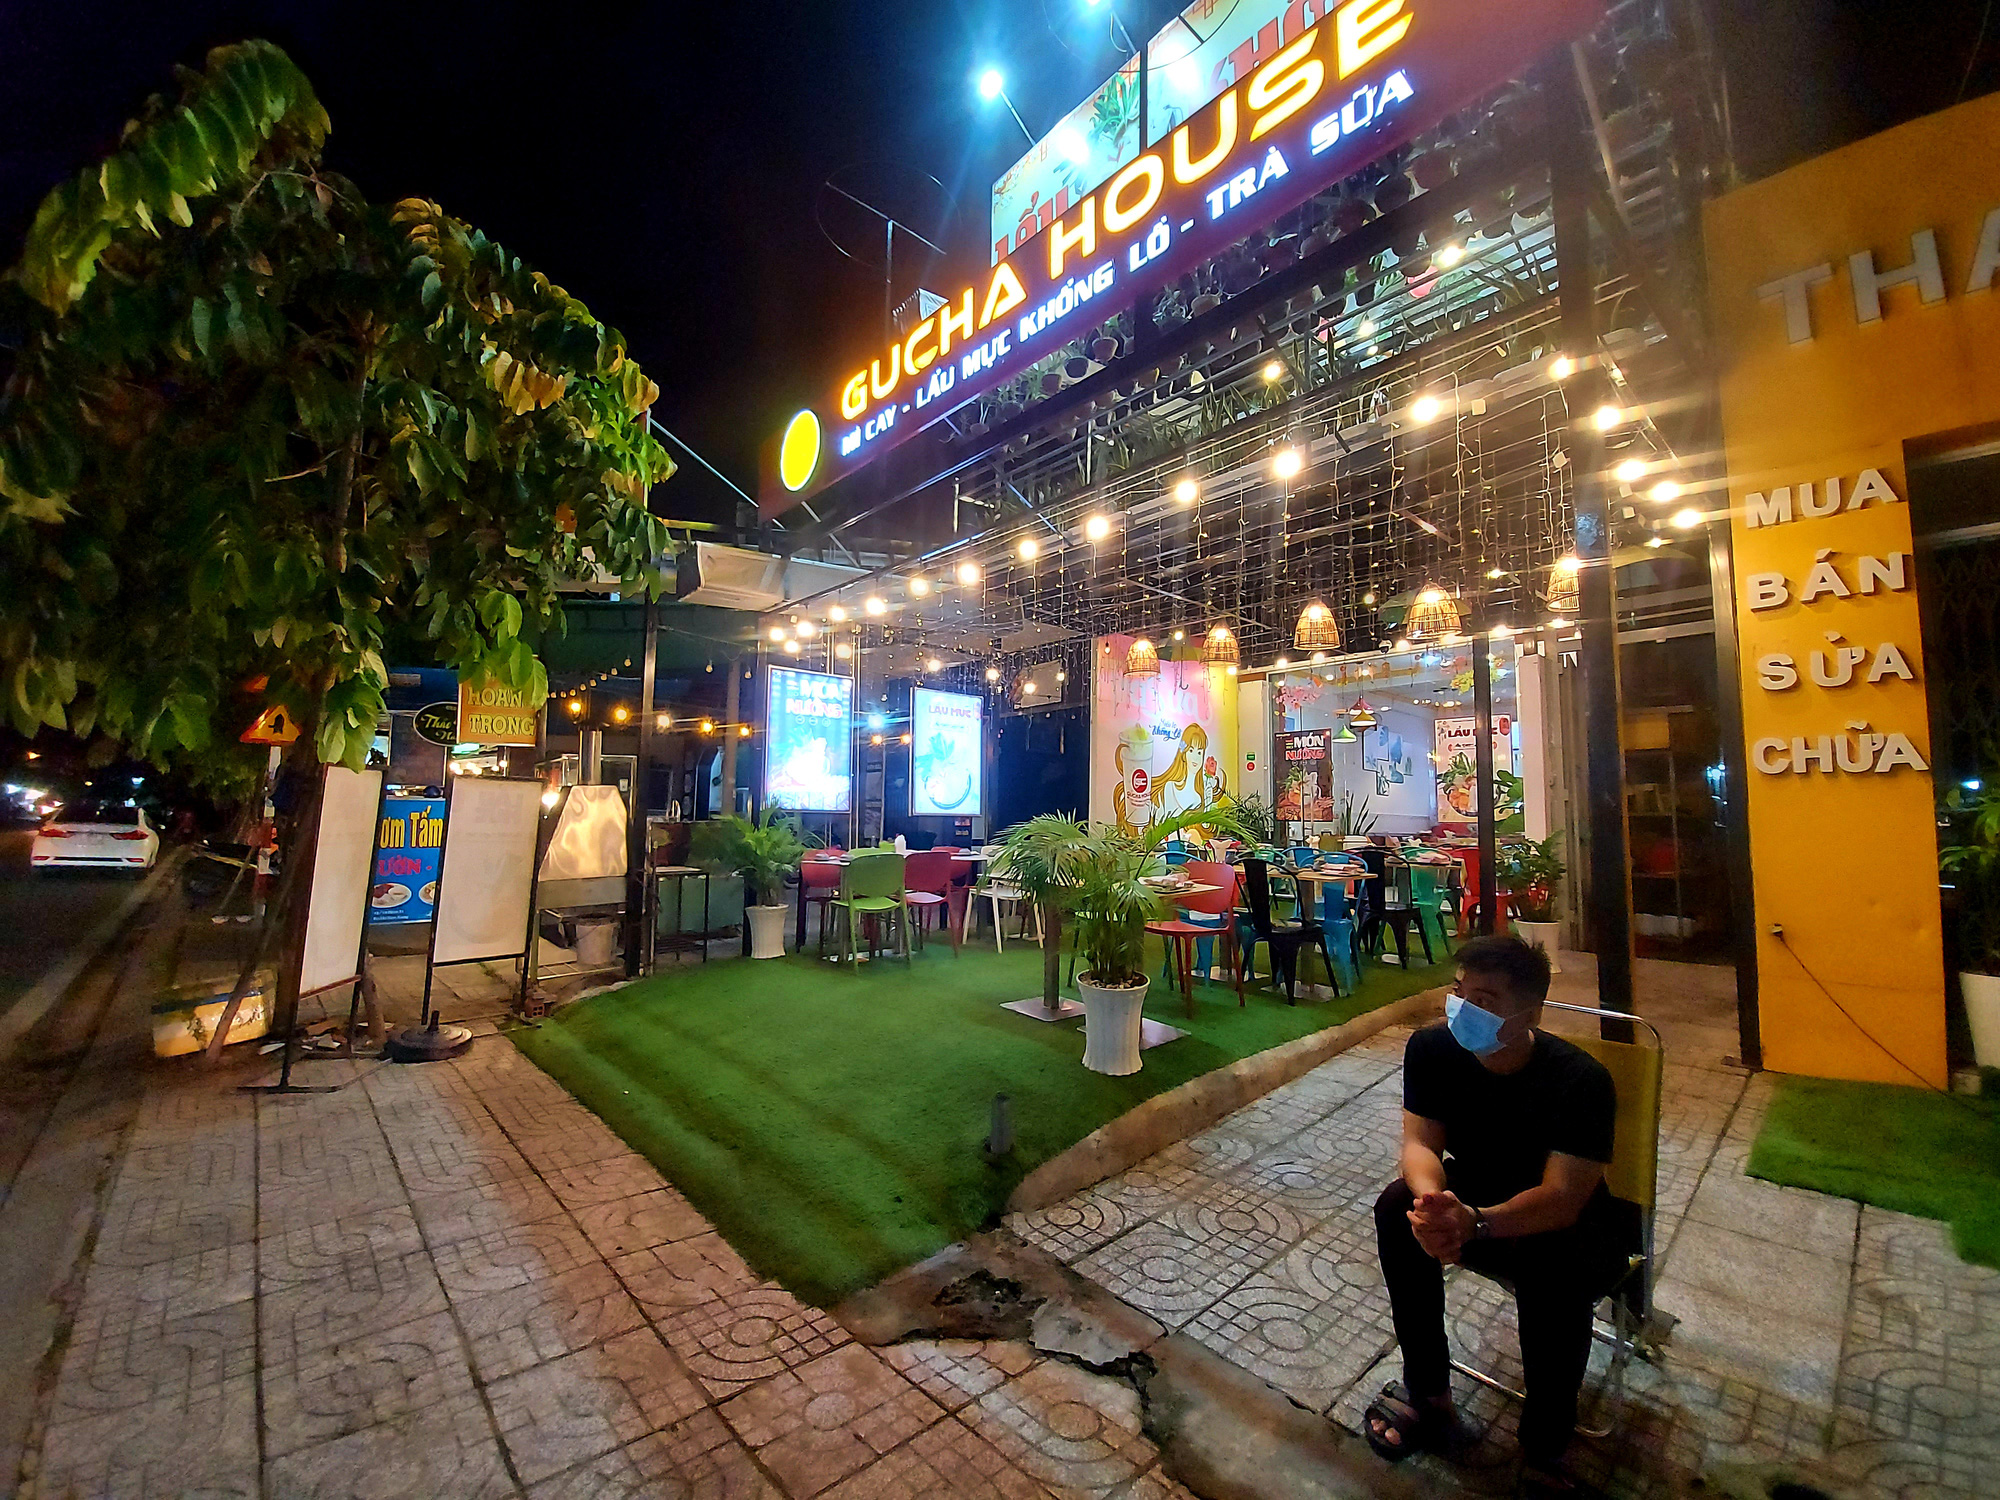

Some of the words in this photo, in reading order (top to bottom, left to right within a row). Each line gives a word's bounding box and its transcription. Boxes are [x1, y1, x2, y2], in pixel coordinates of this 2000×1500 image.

[841, 261, 1028, 421] GUCHA
[1049, 0, 1415, 281] HOUSE
[865, 404, 898, 441] CAY
[962, 328, 1012, 381] MỰC
[1019, 259, 1115, 343] KHỔNG
[1206, 146, 1290, 221] TRÀ
[1310, 69, 1415, 156] SỮA
[1745, 468, 1899, 529] MUA
[1747, 548, 1906, 611] BÁN
[1758, 630, 1914, 691] SỬA
[1293, 732, 1325, 748] MÓN
[1753, 720, 1930, 775] CHỮA
[380, 816, 406, 848] ơm
[410, 805, 444, 848] Tấm
